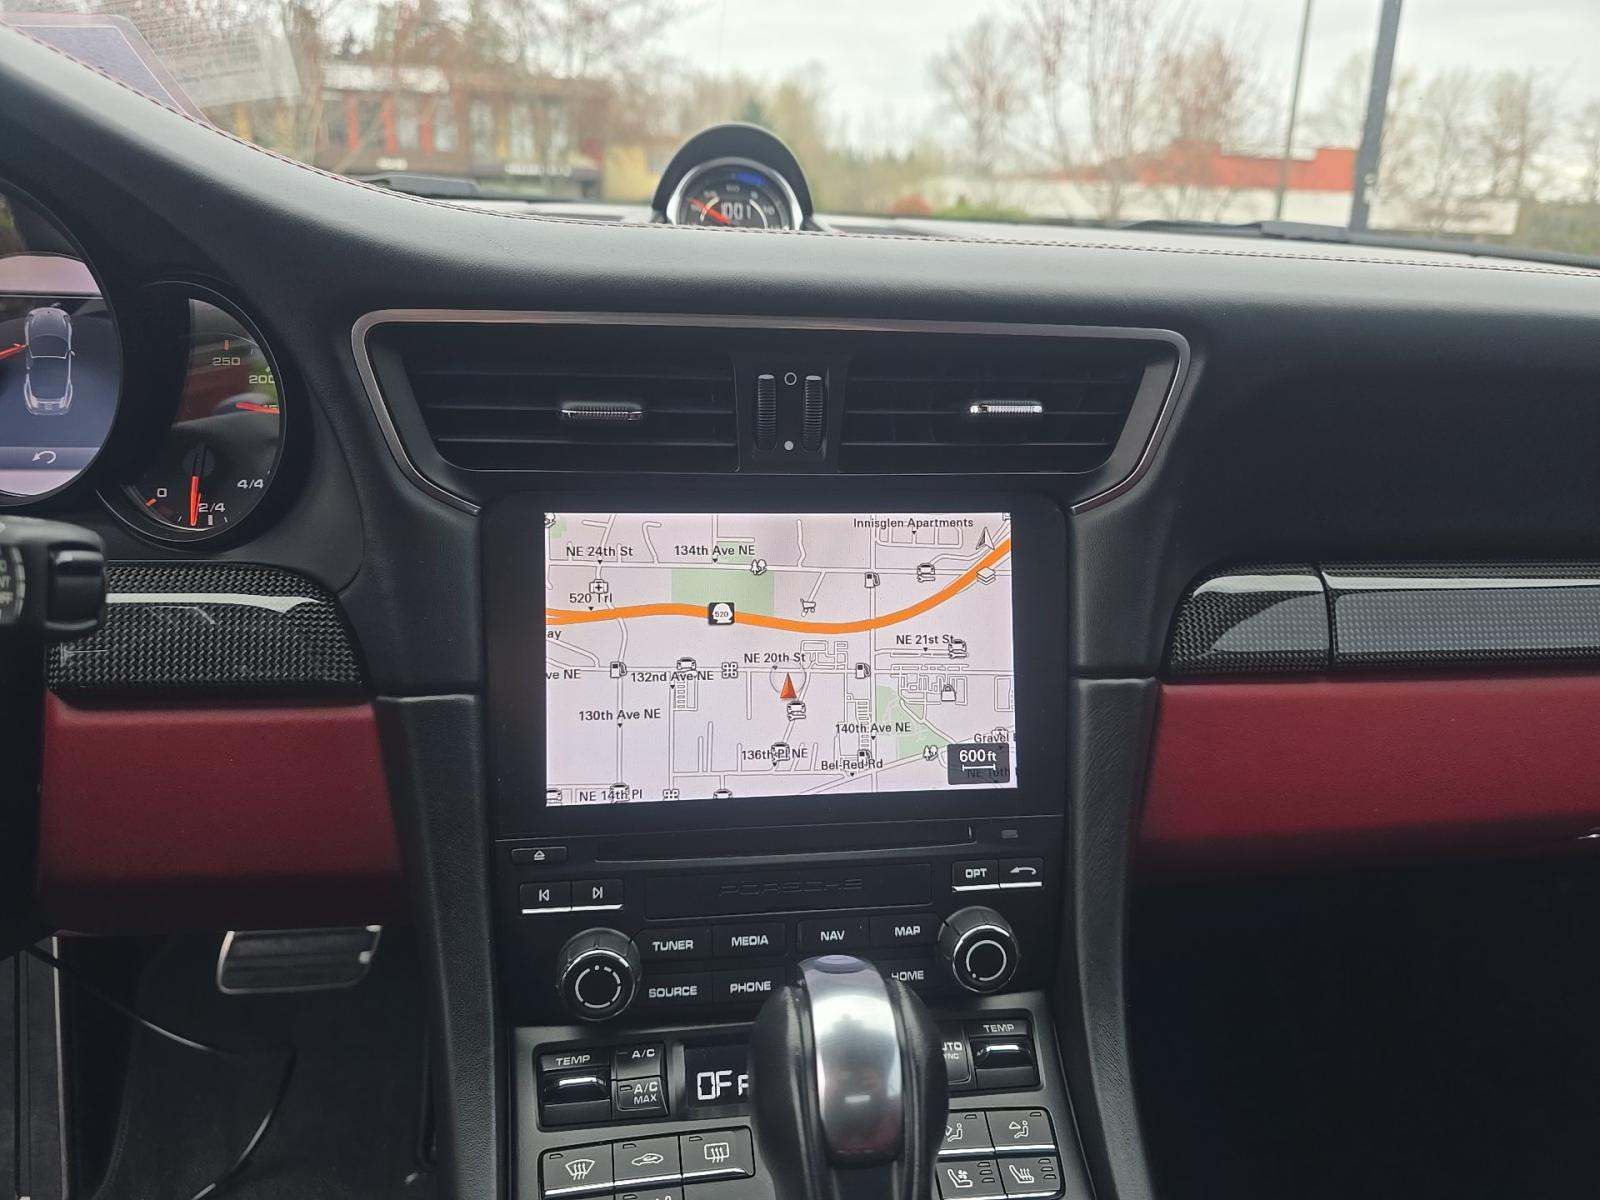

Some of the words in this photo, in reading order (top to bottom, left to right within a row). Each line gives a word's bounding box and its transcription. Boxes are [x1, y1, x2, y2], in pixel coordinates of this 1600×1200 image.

[212, 356, 241, 366] 250
[248, 374, 276, 384] 200
[237, 479, 264, 490] 4/4
[156, 487, 168, 497] 0
[198, 502, 226, 514] 2/4
[853, 517, 904, 529] Innisglen
[907, 516, 974, 529] Apartments
[566, 546, 584, 556] NE
[588, 546, 616, 557] 24th
[620, 546, 633, 557] St
[674, 545, 709, 556] 134th
[712, 545, 735, 556] Ave
[739, 544, 756, 556] NE
[569, 593, 592, 604] 520
[597, 593, 613, 603] Trl
[714, 610, 729, 618] 520
[896, 635, 912, 645] NE
[916, 634, 939, 645] 21st
[942, 634, 954, 645] St
[744, 652, 760, 664] NE
[764, 652, 789, 663] 20th
[793, 651, 807, 663] St
[563, 669, 581, 680] NE
[631, 671, 667, 683] 132nd
[670, 670, 695, 681] Ave
[698, 669, 714, 680] NE
[578, 709, 613, 721] 130th
[616, 709, 641, 720] Ave
[644, 708, 661, 719] NE
[836, 723, 867, 733] 140th
[870, 722, 893, 733] Ave
[896, 721, 911, 732] NE
[973, 732, 1009, 743] Gravel
[742, 750, 773, 760] 136th
[793, 748, 808, 759] NE
[959, 749, 986, 763] 600
[987, 750, 997, 762] ft
[821, 759, 863, 770] Bel-Red
[867, 758, 884, 769] Rd
[579, 791, 597, 802] NE
[600, 789, 628, 800] 14th
[631, 788, 643, 799] Pl
[965, 868, 987, 879] OPT
[820, 930, 846, 942] NAV
[894, 925, 921, 938] MAP
[652, 939, 694, 951] TUNER
[731, 934, 769, 947] MEDIA
[891, 970, 925, 982] HOME
[648, 985, 698, 998] SOURCE
[729, 981, 772, 994] PHONE
[983, 1023, 1015, 1033] TEMP
[942, 1041, 963, 1051] UTO
[556, 1054, 591, 1066] TEMP
[631, 1049, 656, 1059] A/C
[633, 1081, 658, 1095] A/C
[633, 1094, 657, 1105] MAX
